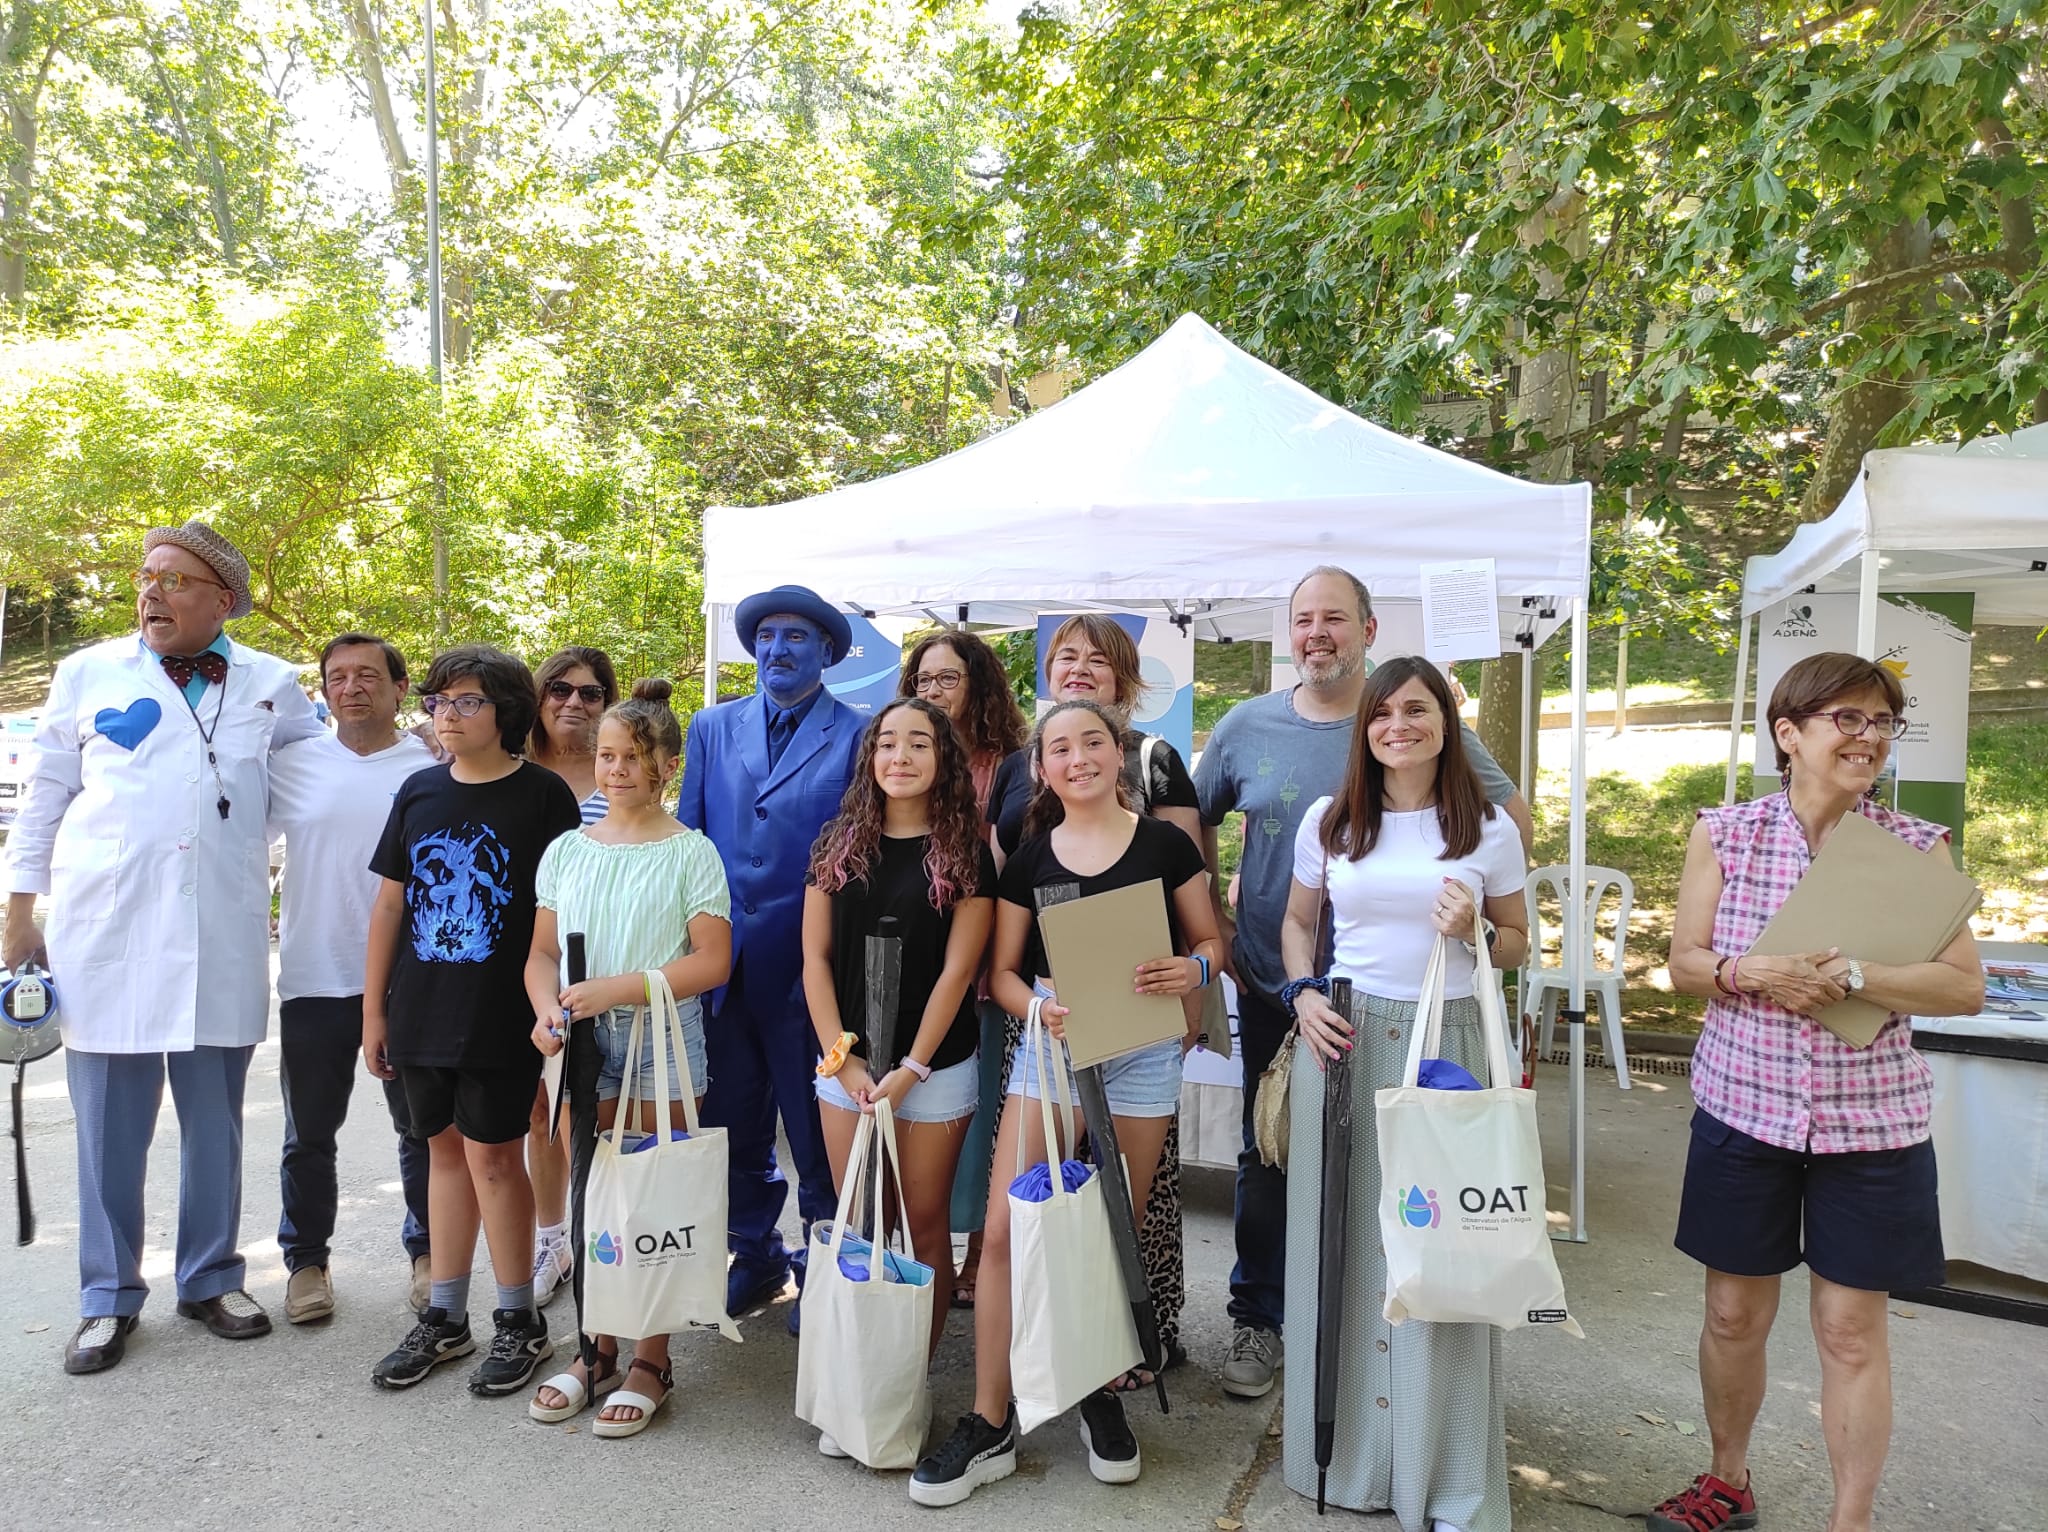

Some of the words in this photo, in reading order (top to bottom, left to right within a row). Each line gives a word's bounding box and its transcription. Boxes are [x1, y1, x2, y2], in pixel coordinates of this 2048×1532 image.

[1772, 629, 1818, 637] ADENC
[1459, 1185, 1528, 1213] OAT
[635, 1225, 696, 1254] OAT
